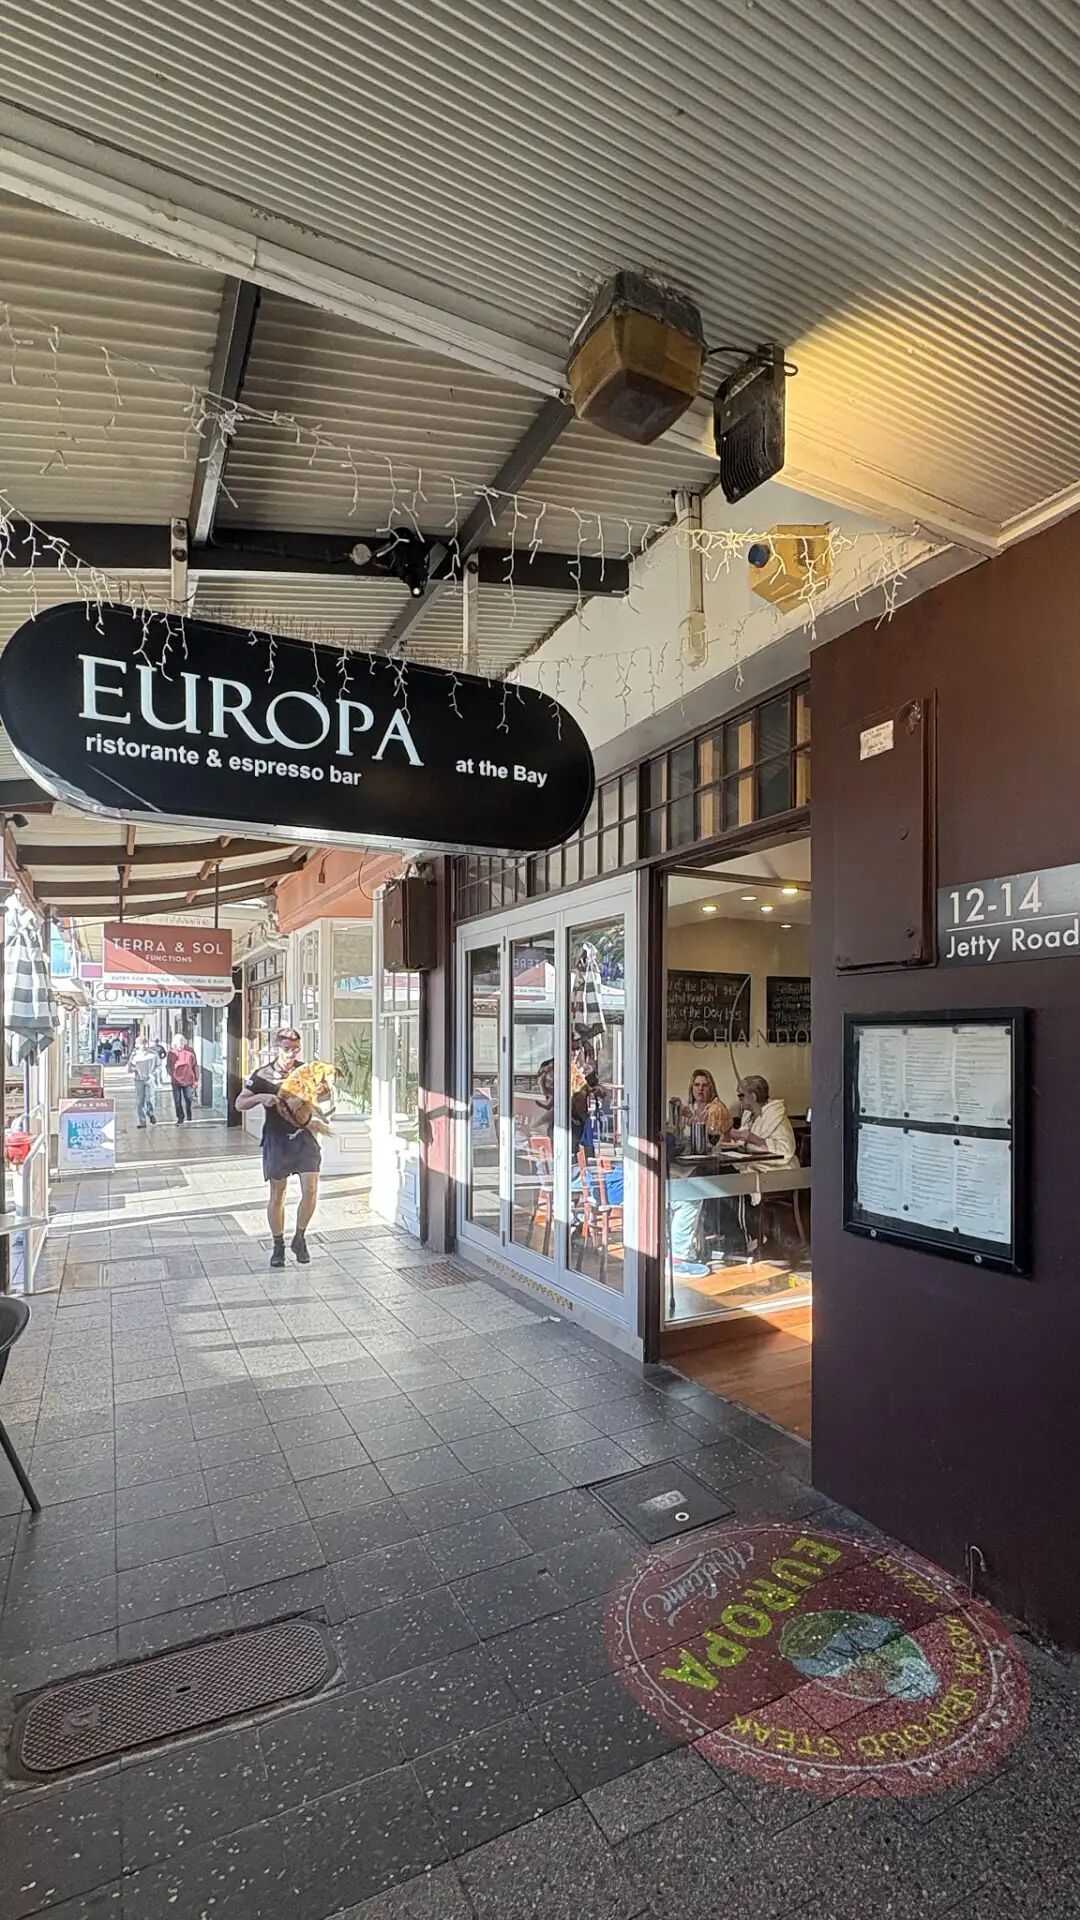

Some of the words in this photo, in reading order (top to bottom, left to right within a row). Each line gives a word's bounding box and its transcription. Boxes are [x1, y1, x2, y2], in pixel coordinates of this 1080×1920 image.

[78, 653, 425, 767] EUROPA
[85, 733, 200, 766] ristorante
[206, 748, 223, 769] &
[229, 754, 324, 781] espresso
[330, 765, 362, 786] bar
[456, 758, 475, 775] at
[479, 760, 508, 779] the
[513, 765, 548, 788] Bay
[949, 876, 1043, 924] 12-14
[112, 938, 166, 952] TERRA
[174, 941, 185, 953] &
[192, 942, 224, 955] SOL
[145, 954, 192, 963] FUNCTIONS
[946, 935, 1001, 961] Jetty
[1012, 918, 1080, 952] Road
[659, 1538, 842, 1690] EUROPA
[730, 1714, 840, 1757] STEAK
